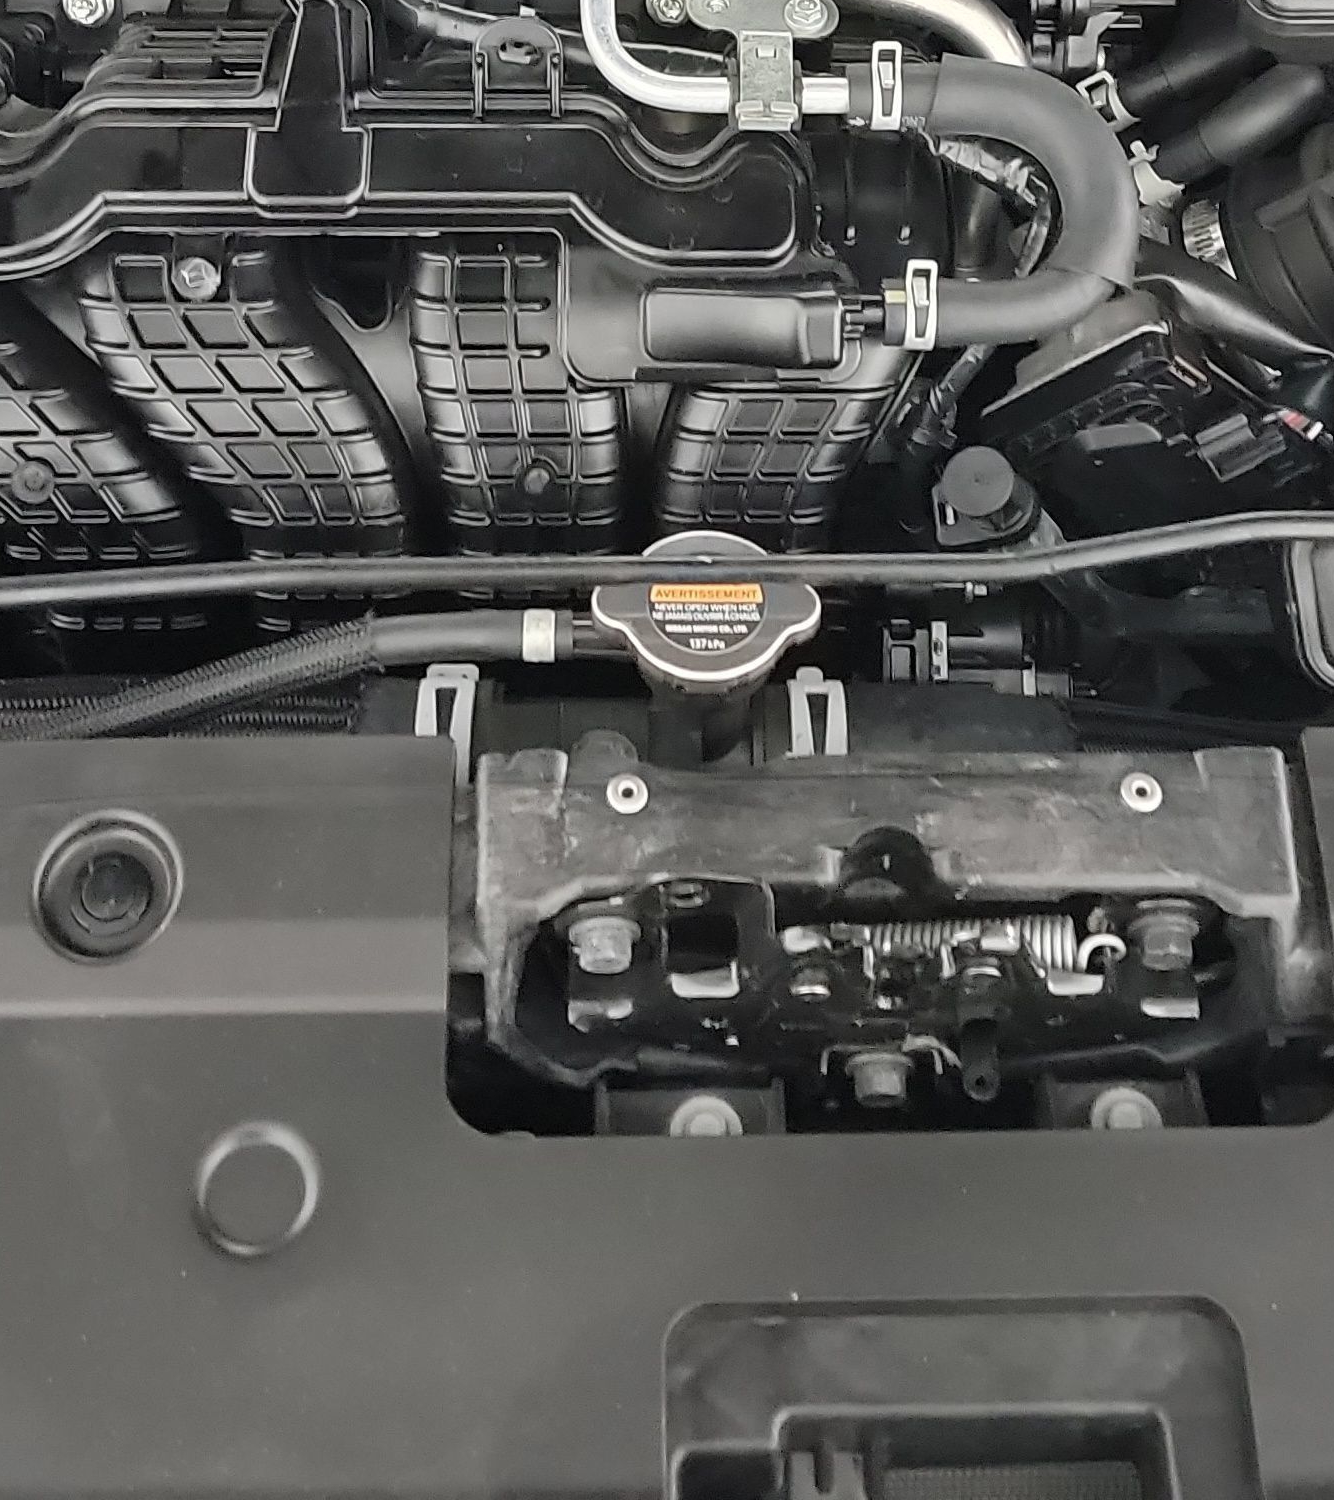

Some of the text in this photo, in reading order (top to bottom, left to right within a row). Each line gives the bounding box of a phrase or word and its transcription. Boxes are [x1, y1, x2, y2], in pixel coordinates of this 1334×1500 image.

[655, 589, 758, 598] AVERTISSEMENT
[655, 603, 684, 611] NEVER
[684, 603, 709, 611] OPEN
[710, 603, 737, 611] WHEN
